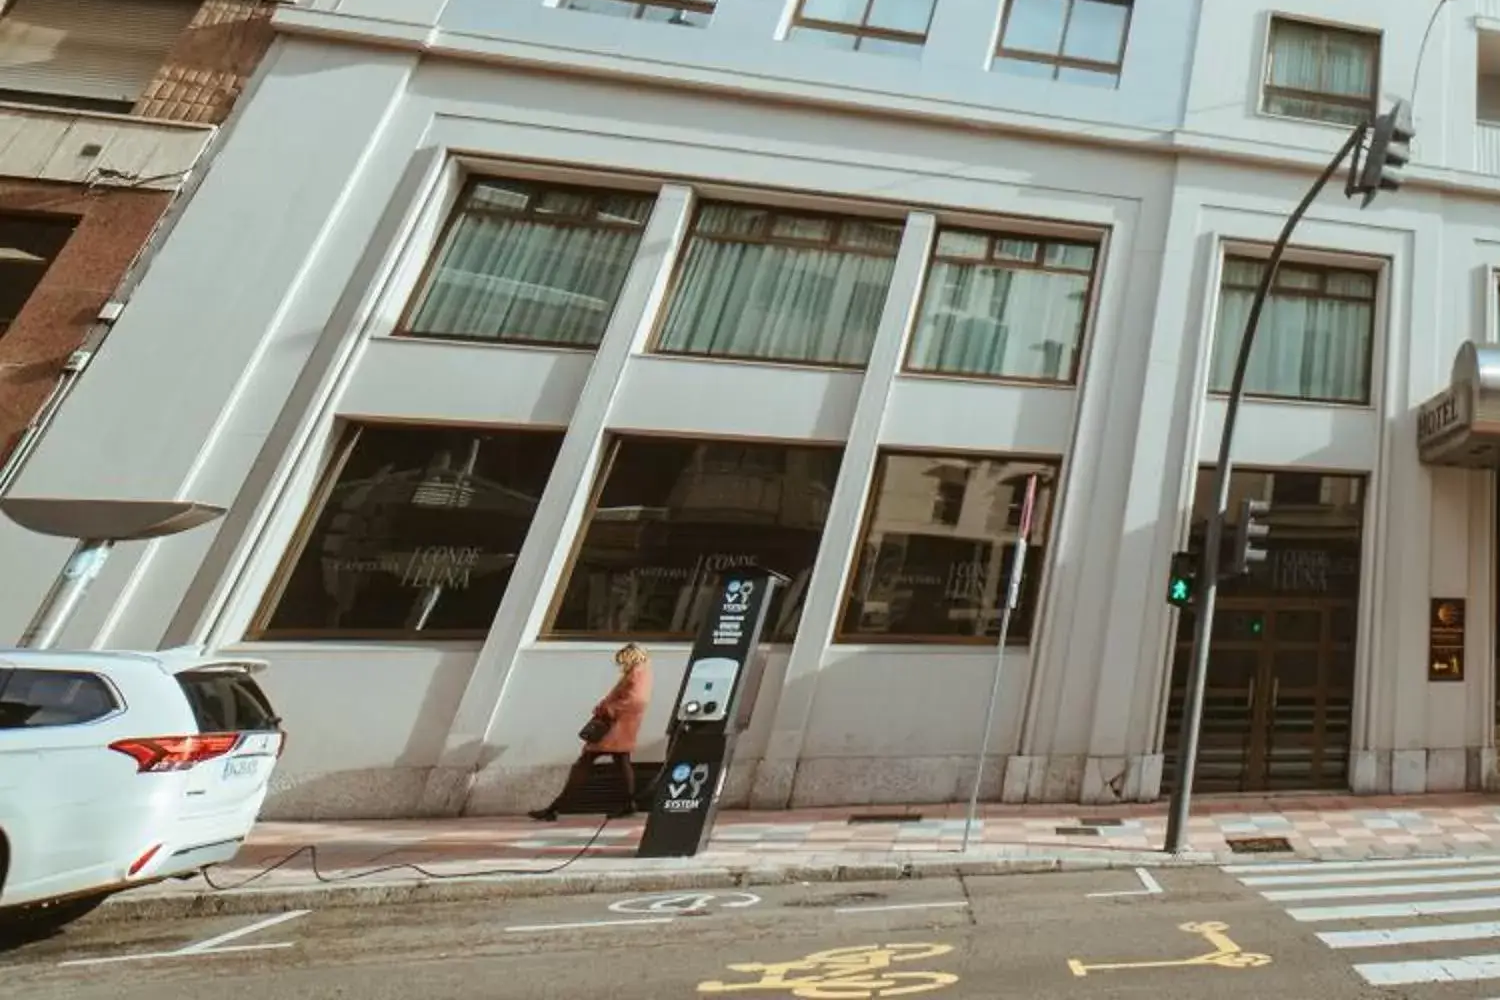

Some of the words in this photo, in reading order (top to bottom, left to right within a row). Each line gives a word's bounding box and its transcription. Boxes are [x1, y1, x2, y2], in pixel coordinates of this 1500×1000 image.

[1419, 395, 1458, 439] HOTEL
[422, 546, 483, 567] CONDE
[411, 566, 470, 590] LUNA
[664, 799, 699, 809] SYSTEM
